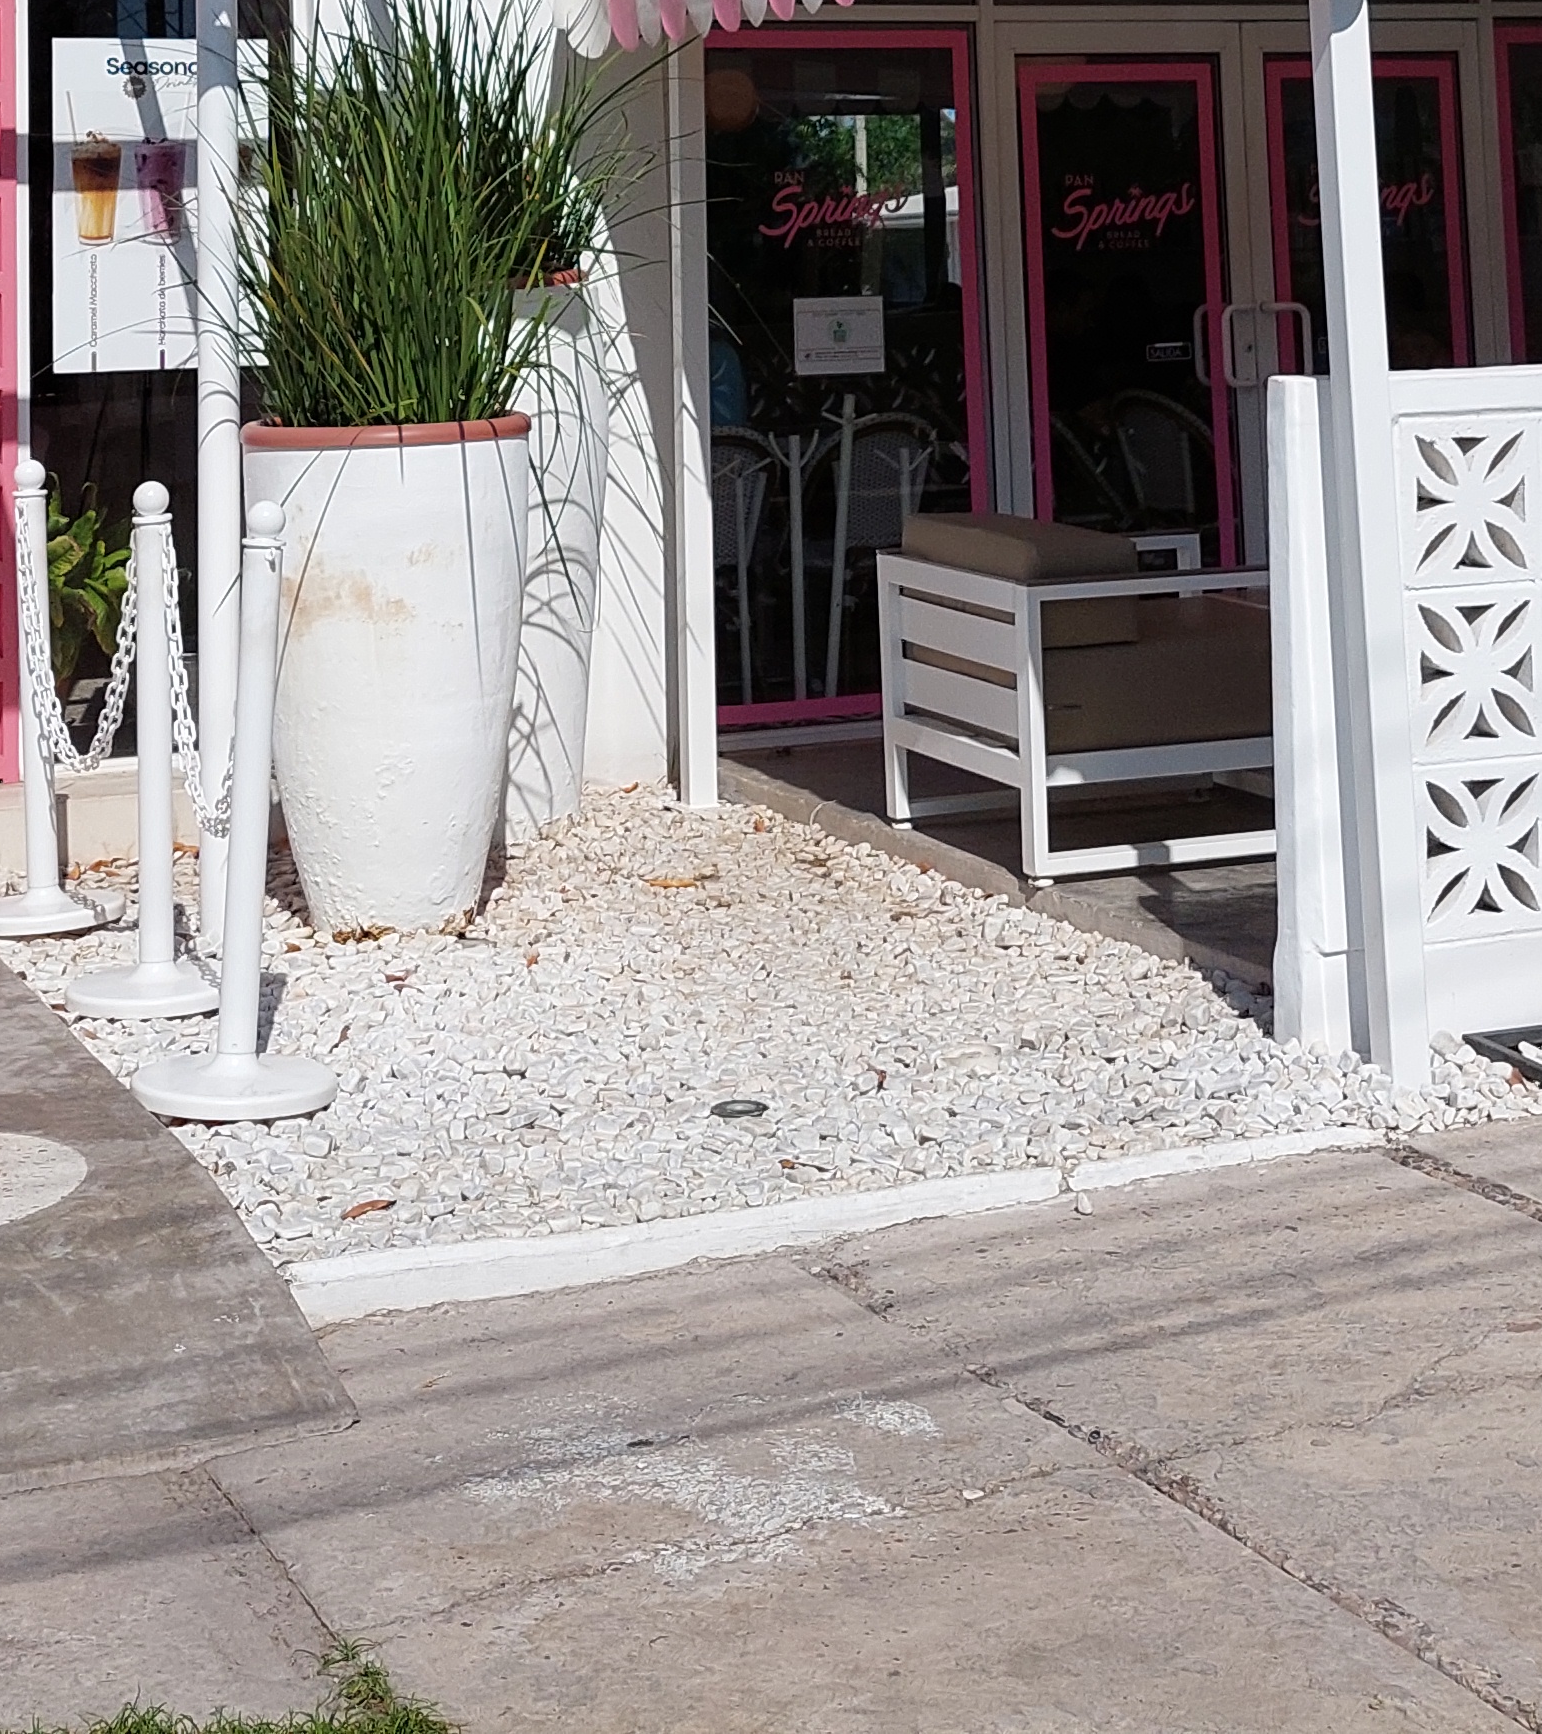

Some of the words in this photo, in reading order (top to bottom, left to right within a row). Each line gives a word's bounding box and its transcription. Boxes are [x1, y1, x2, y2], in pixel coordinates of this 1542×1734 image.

[106, 58, 198, 75] Seasona
[775, 171, 805, 184] PAN
[1065, 175, 1094, 187] PAN
[759, 183, 909, 249] Springs
[1052, 183, 1196, 252] Springs
[816, 228, 852, 237] BREAD
[818, 237, 861, 247] COFFEE
[89, 254, 98, 306] Macchiato
[158, 254, 166, 286] berries
[89, 307, 98, 347] Caramel
[158, 301, 166, 345] Horchata
